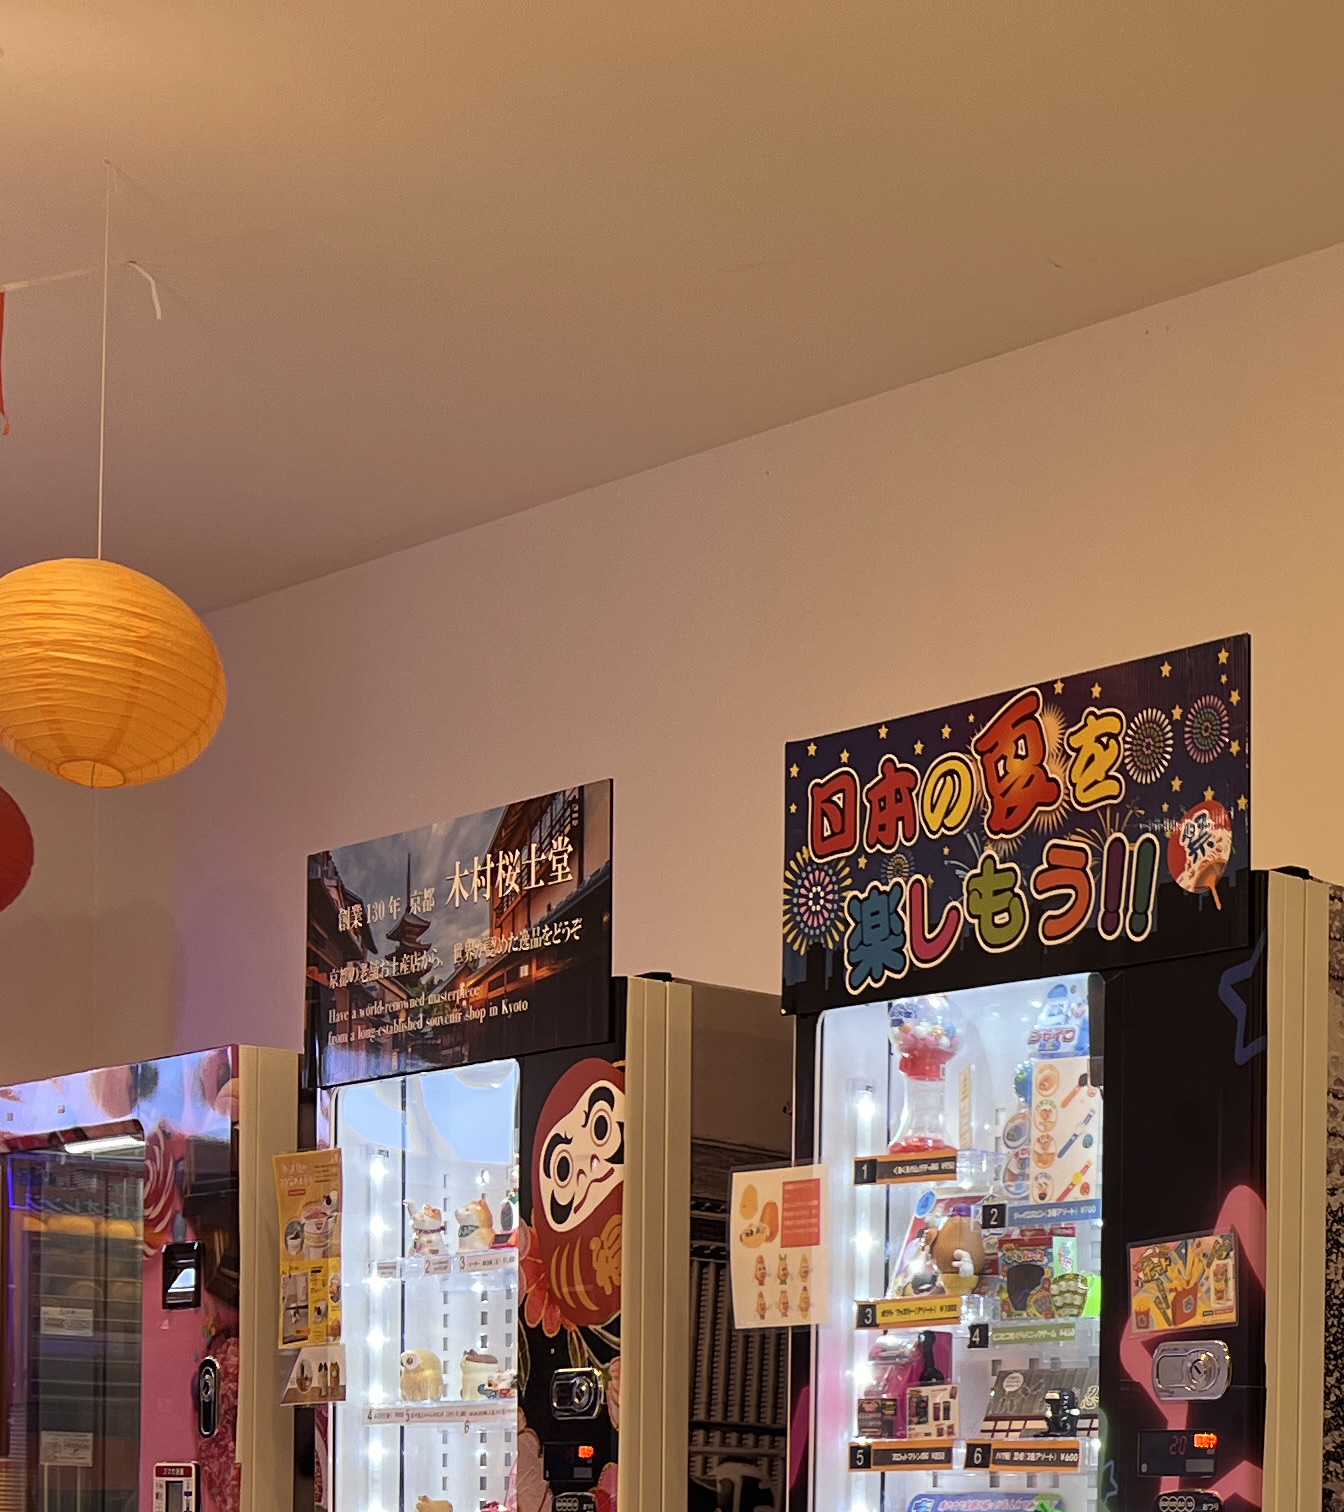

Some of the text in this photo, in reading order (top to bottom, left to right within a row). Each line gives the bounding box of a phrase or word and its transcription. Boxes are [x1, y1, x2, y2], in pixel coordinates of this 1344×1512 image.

[806, 686, 1128, 864] 日本の夏を
[366, 900, 385, 925] 130
[388, 896, 401, 920] 年
[410, 887, 436, 916] 京都
[328, 1006, 350, 1024] Have
[351, 1010, 357, 1021] a
[328, 1028, 348, 1046] from
[465, 1005, 486, 1024] shop
[489, 1002, 499, 1016] in
[501, 998, 529, 1019] Kyoto
[856, 1449, 865, 1465] 5
[973, 1447, 983, 1464] 6
